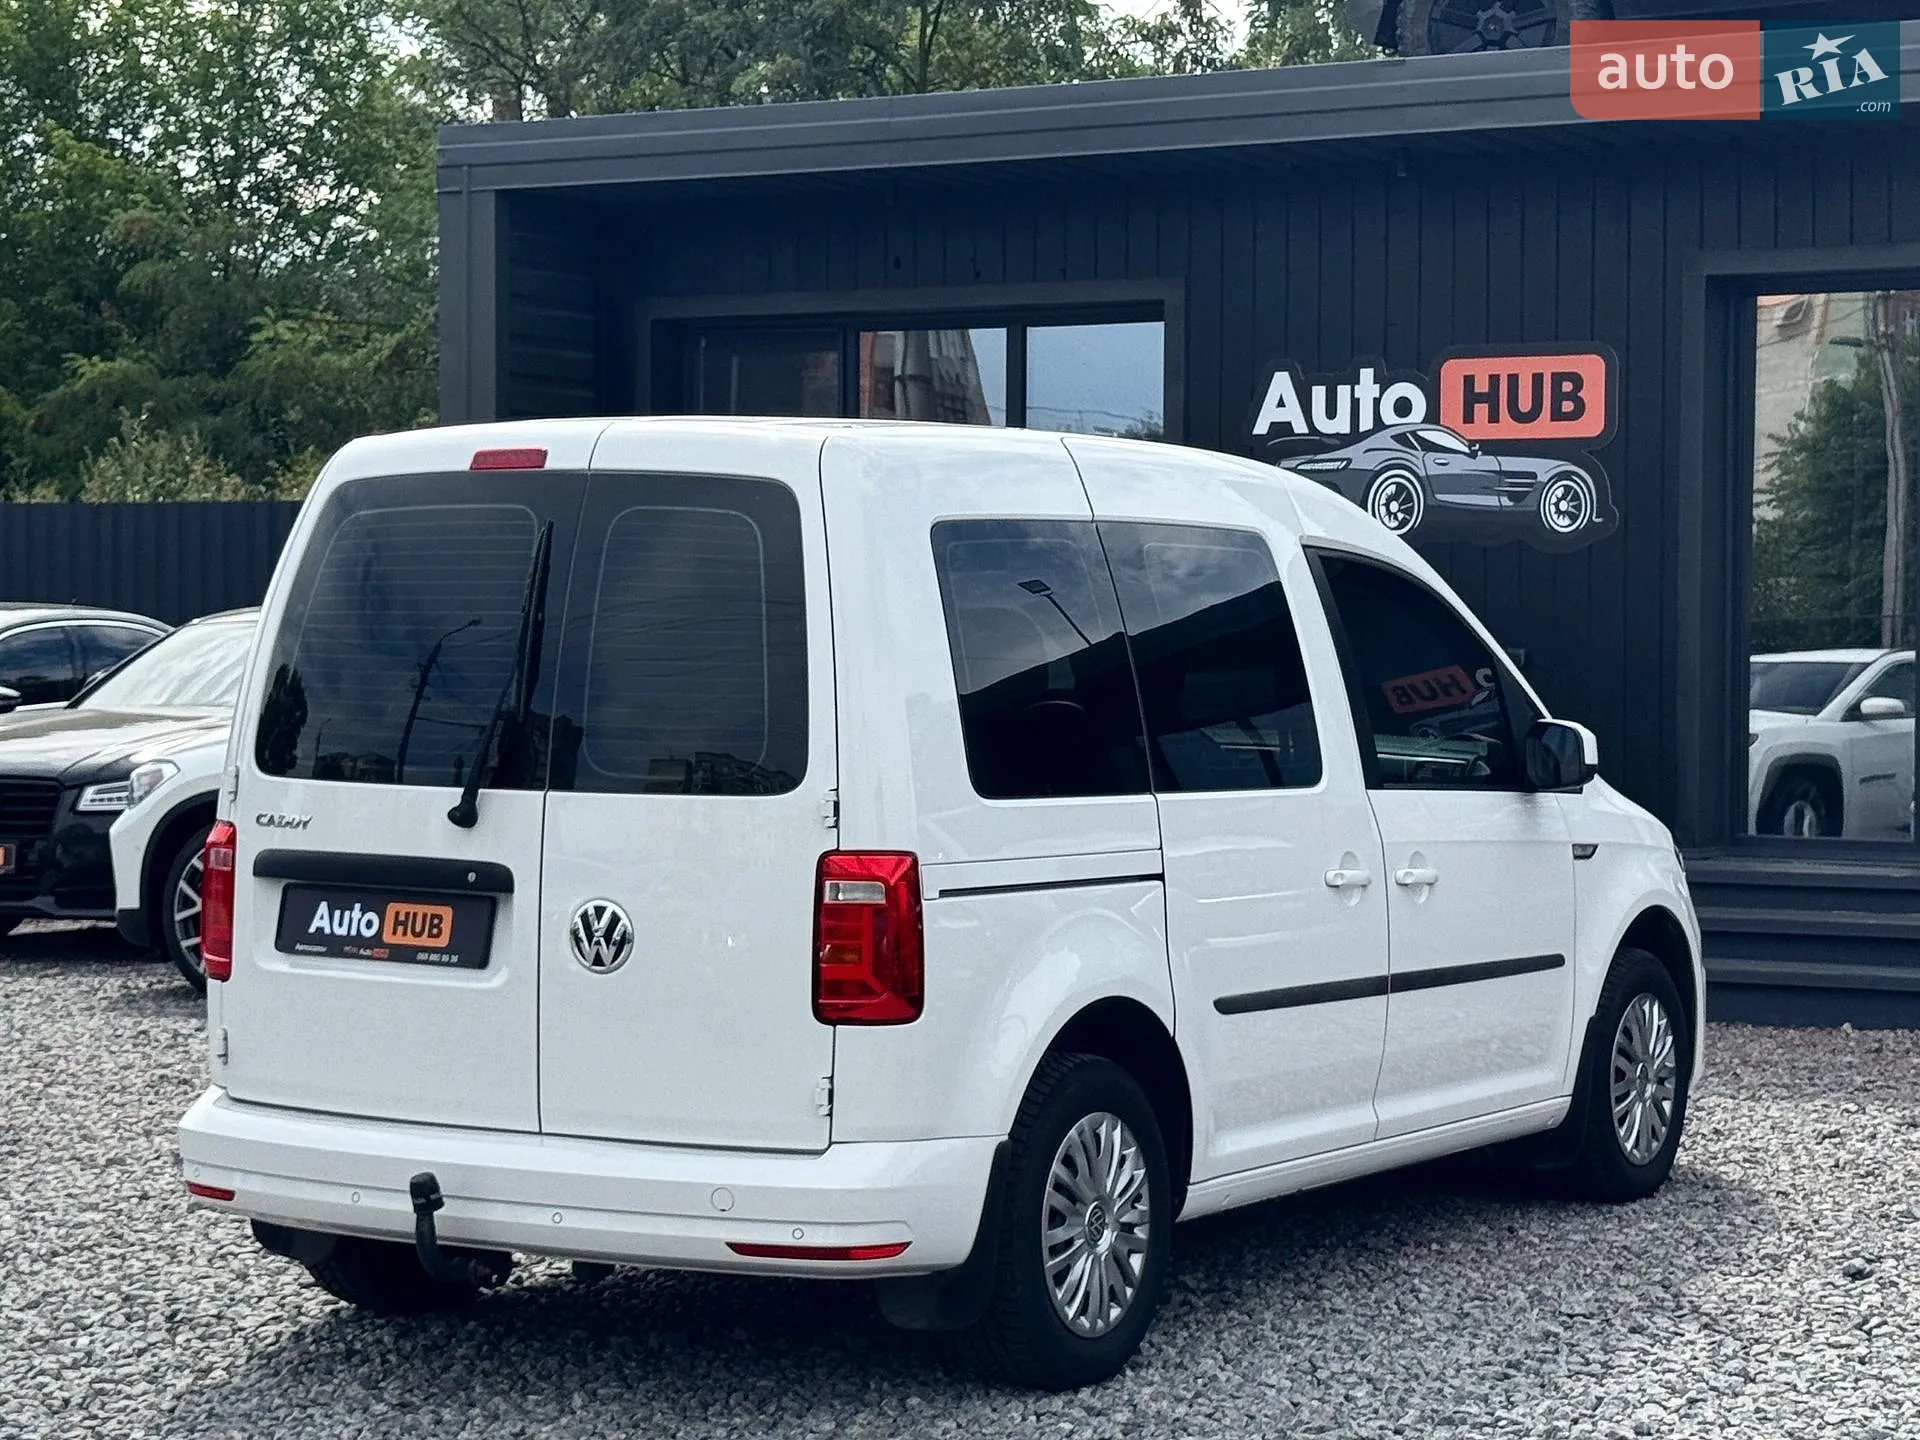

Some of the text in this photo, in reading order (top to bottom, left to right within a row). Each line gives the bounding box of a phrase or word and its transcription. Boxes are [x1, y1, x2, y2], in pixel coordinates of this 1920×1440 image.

[1252, 367, 1587, 435] Auto HUB
[256, 813, 313, 830] CADDY
[308, 901, 444, 939] Auto HUB
